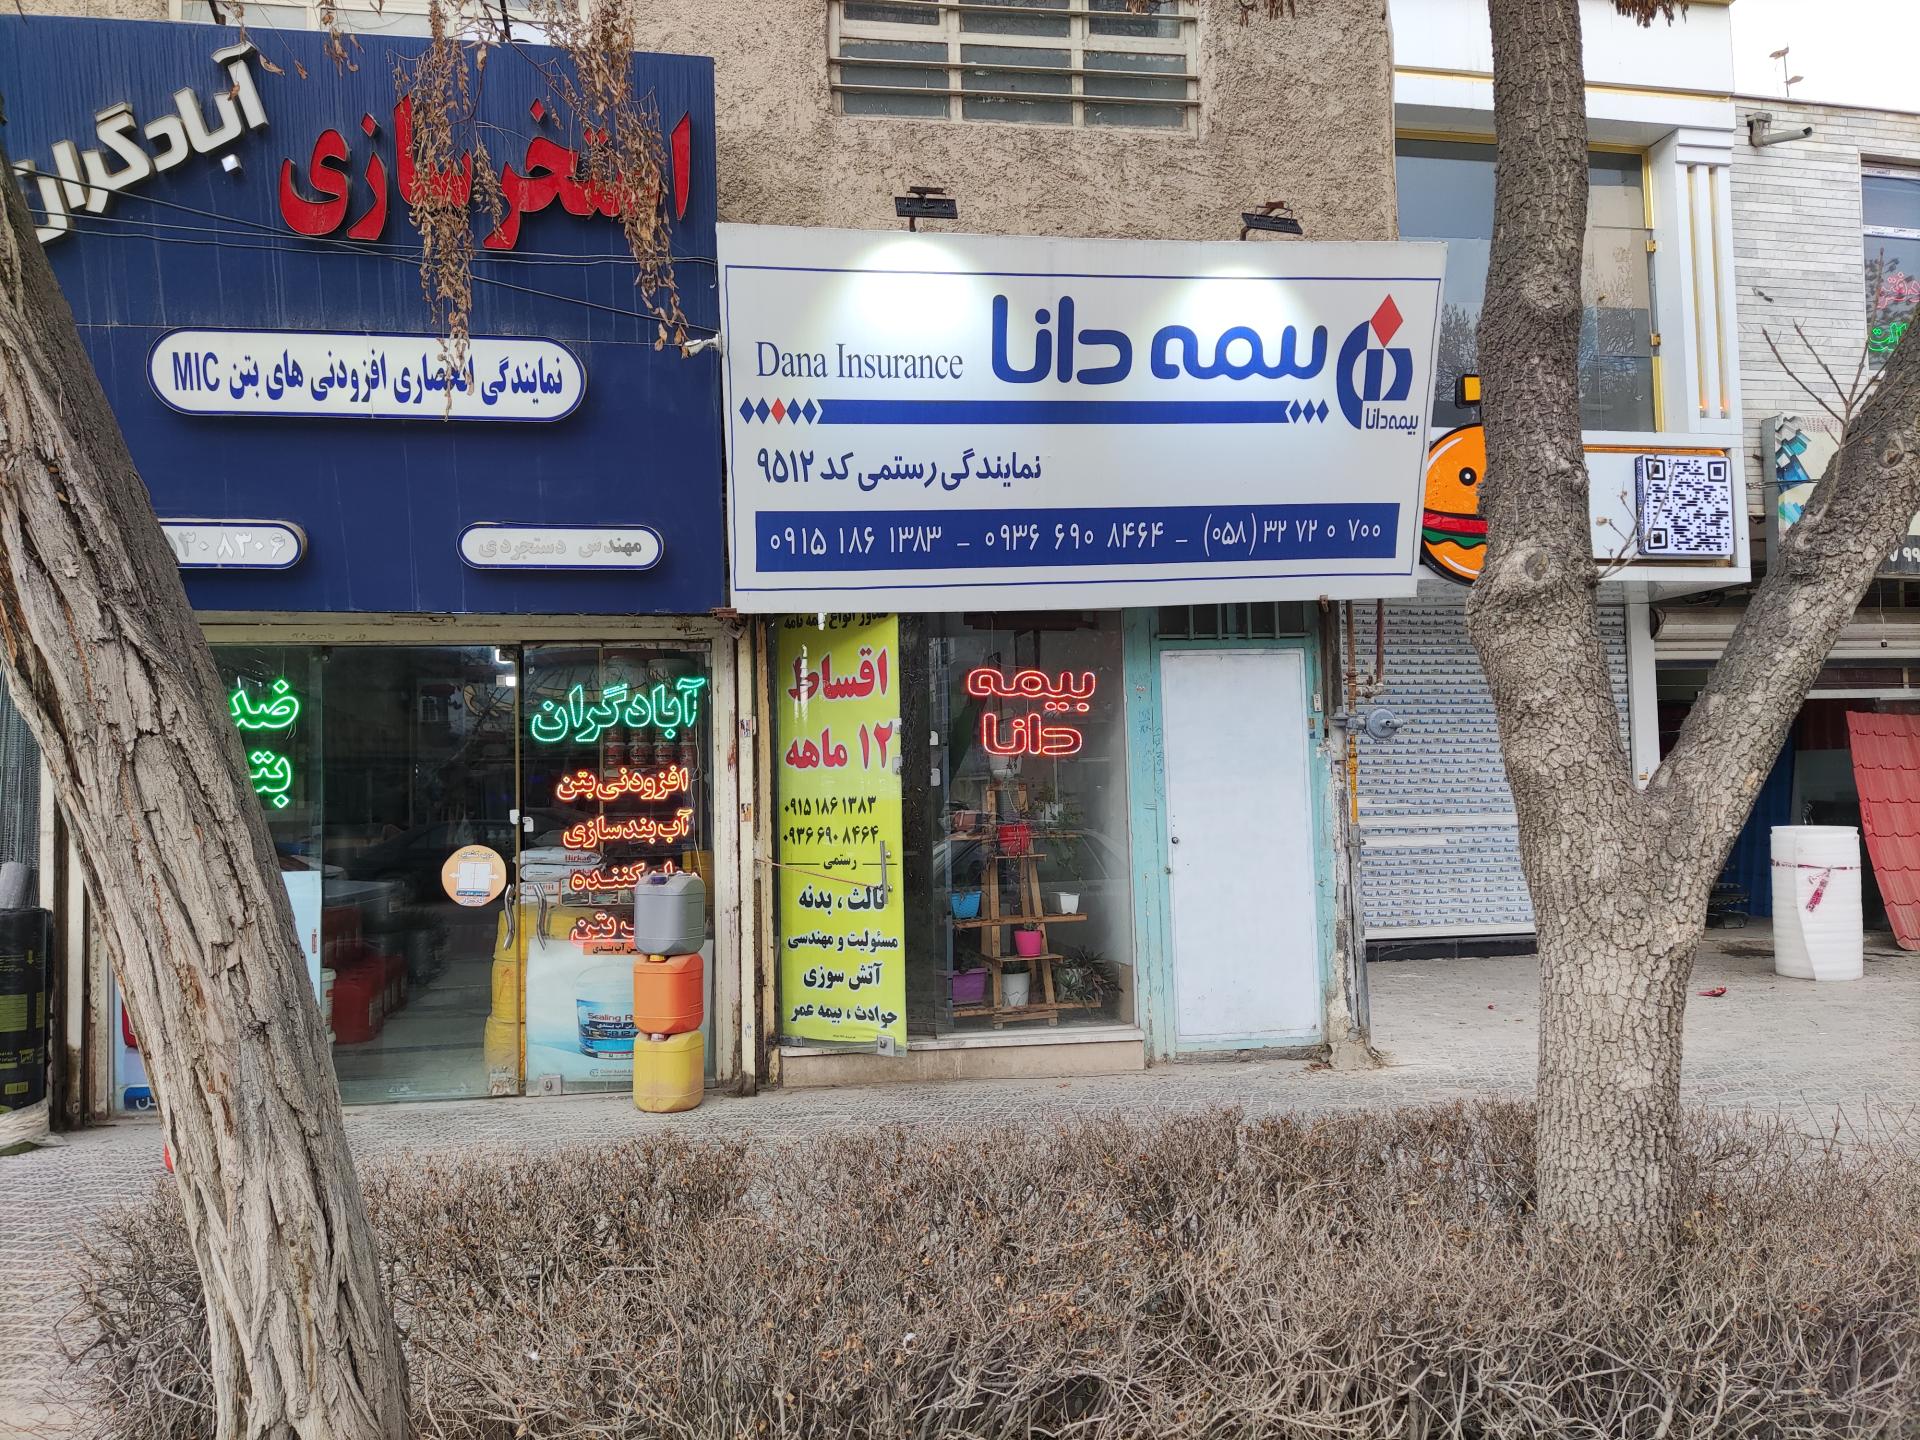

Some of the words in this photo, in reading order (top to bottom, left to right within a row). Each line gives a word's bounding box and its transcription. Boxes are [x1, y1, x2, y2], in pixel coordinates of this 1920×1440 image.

[12, 40, 268, 243] آبادگران
[992, 294, 1133, 384] دانا
[1151, 325, 1328, 382] بیمه
[172, 352, 220, 391] MIC
[229, 355, 260, 400] بتن
[266, 348, 304, 400] های
[311, 348, 387, 403] افزودنی
[755, 341, 828, 378] Dana
[836, 343, 963, 379] Insurance
[482, 355, 562, 406] نمایندگی
[1365, 408, 1389, 430] دانا
[1389, 414, 1419, 435] بیمه
[757, 448, 814, 483] ۹۵۱۲
[820, 451, 854, 480] کد
[858, 455, 938, 491] رستمی
[941, 448, 1042, 488] نمایندگی
[578, 535, 642, 558] مهندس
[770, 527, 827, 555] ۰۹۱۵
[838, 527, 875, 555] ۱۸۶
[889, 525, 942, 553] ۱۳۸۳
[985, 523, 1040, 551] ۰۹۳۶
[1054, 523, 1094, 550] ۶۹۰
[1107, 521, 1164, 549] ۸۴۶۴
[788, 648, 888, 701] اقساط
[968, 667, 1096, 712] بیمه
[531, 677, 706, 742] آبادگران
[785, 728, 848, 769] ماهه
[859, 720, 893, 769] ۱۲
[983, 713, 1083, 755] دانا
[250, 750, 291, 808] بت
[556, 771, 596, 801] بتن
[596, 765, 689, 801] افزودنی
[784, 797, 812, 816] ۰۹۱۵
[815, 796, 838, 815] ۱۸۶
[842, 795, 877, 814] ۱۳۸۳
[658, 808, 694, 844] آب
[842, 825, 879, 845] ۸۴۶۴
[571, 862, 646, 890] کننده
[823, 854, 857, 870] رستمی
[798, 885, 832, 915] بدنه
[788, 930, 834, 949] مهندسی
[837, 936, 844, 952] و
[847, 930, 898, 953] مسئولیت
[803, 966, 845, 989] سوزی
[848, 963, 883, 991] آتش
[791, 1004, 815, 1022] عمر
[818, 1004, 842, 1024] بیمه
[855, 1005, 898, 1029] حوادث
